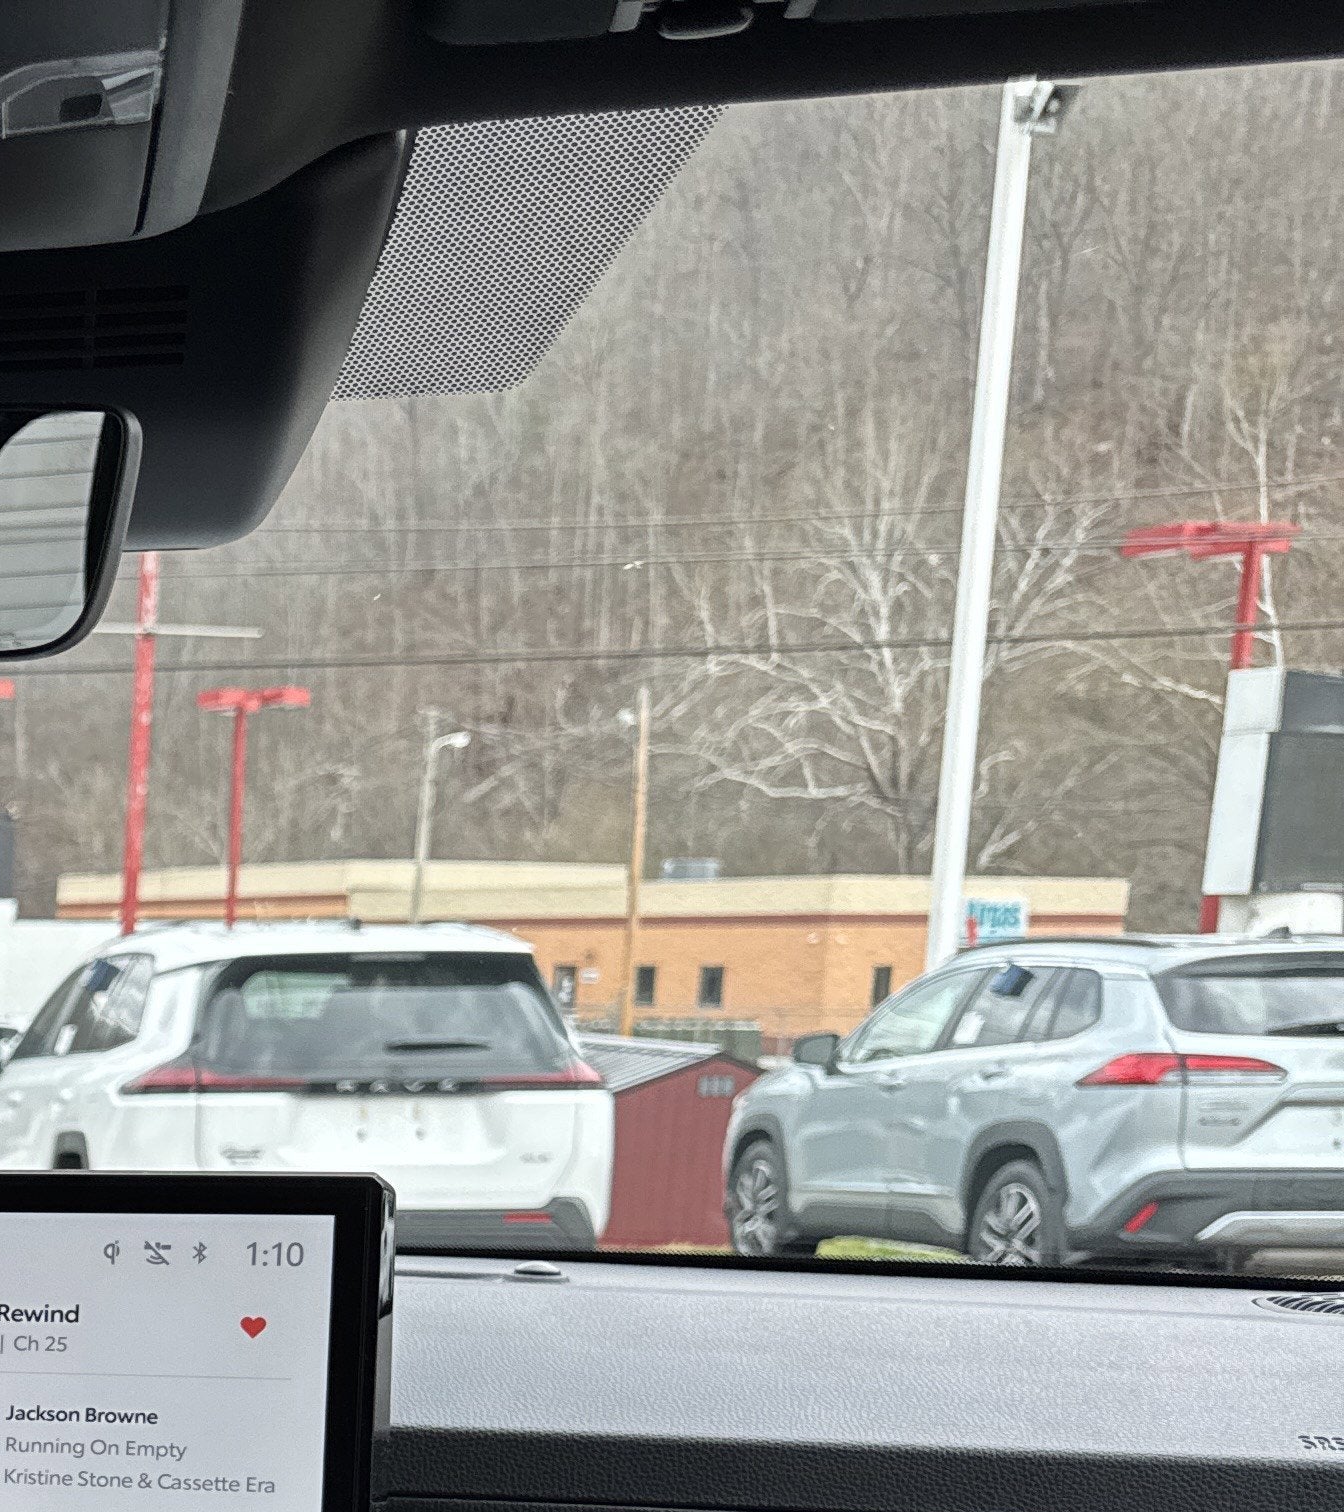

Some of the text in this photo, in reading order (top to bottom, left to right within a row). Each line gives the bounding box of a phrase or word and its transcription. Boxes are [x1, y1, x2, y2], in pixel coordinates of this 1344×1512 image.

[245, 1241, 304, 1267] 1:10
[13, 1335, 41, 1352] Ch
[44, 1335, 68, 1353] 25
[5, 1405, 158, 1425] Jackson Browne
[5, 1437, 187, 1461] Running On Empty
[3, 1468, 276, 1494] Kristine Stone & Cassette Era
